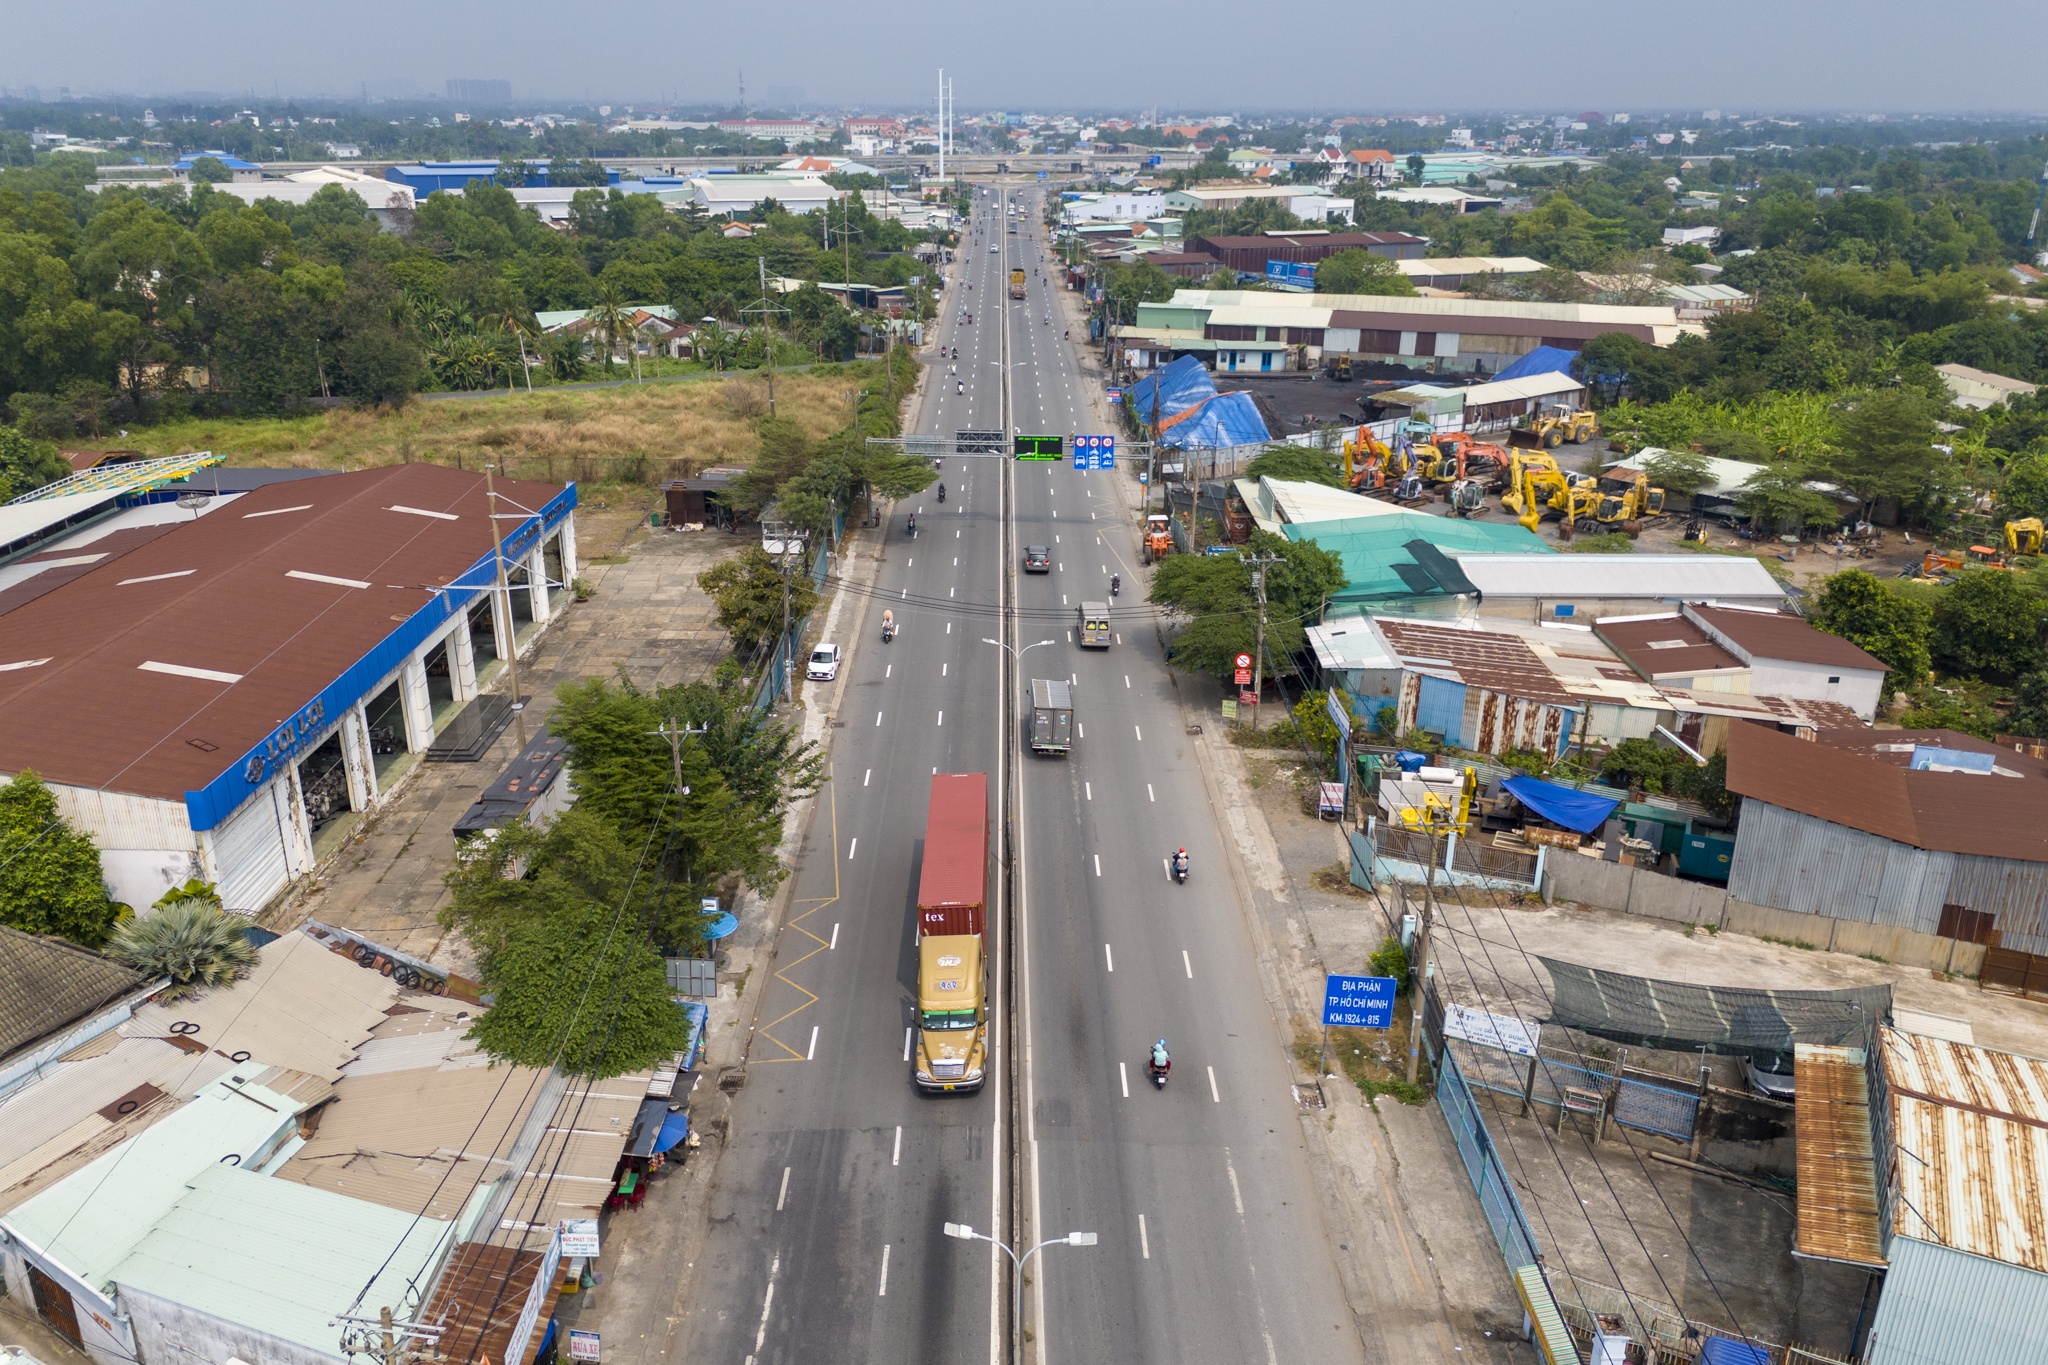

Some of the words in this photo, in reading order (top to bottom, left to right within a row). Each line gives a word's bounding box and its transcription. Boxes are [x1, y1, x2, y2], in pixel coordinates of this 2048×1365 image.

[925, 912, 944, 922] tex
[1342, 980, 1356, 993] ĐỊA
[1357, 979, 1381, 994] PHẬN
[1340, 993, 1352, 1008] HỒ
[1352, 995, 1368, 1009] CHÍ
[1366, 999, 1389, 1010] MINH
[1367, 1014, 1380, 1025] 815
[588, 1344, 599, 1355] XE
